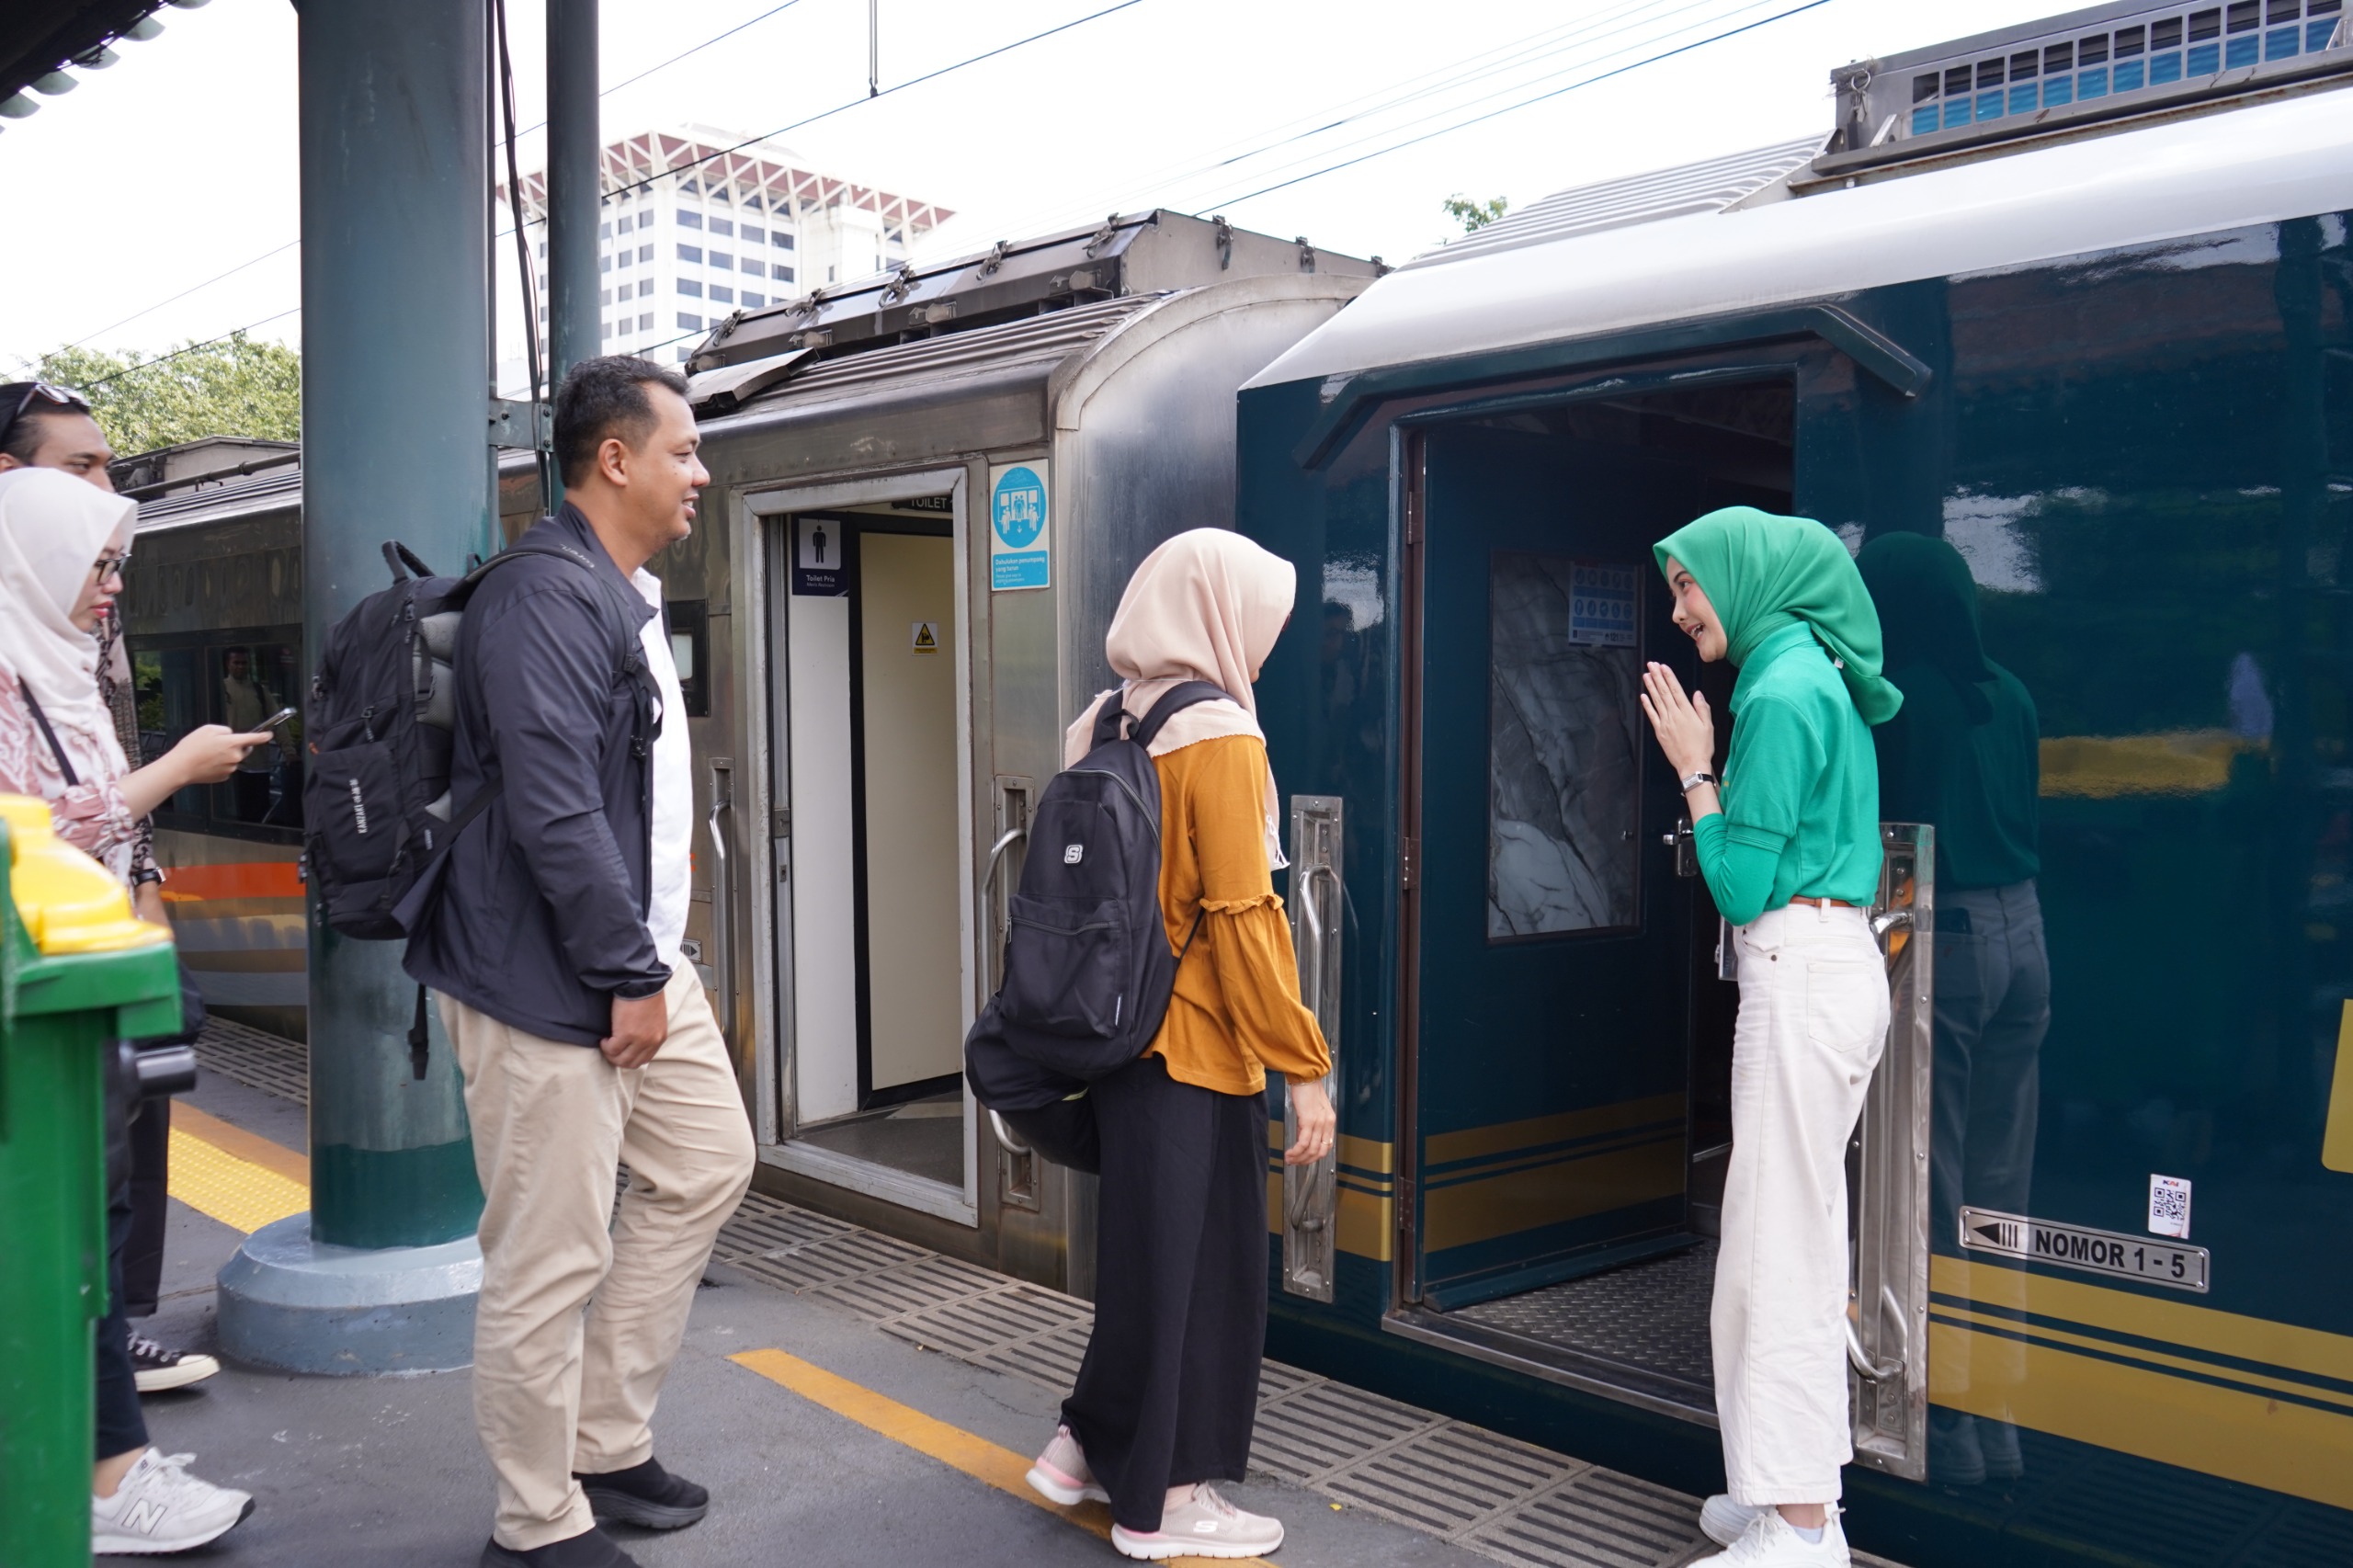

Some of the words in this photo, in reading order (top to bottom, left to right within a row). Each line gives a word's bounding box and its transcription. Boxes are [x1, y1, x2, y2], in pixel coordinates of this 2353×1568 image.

[353, 804, 368, 834] KANZAKI
[2035, 1229, 2125, 1268] NOMOR
[121, 1497, 168, 1536] N
